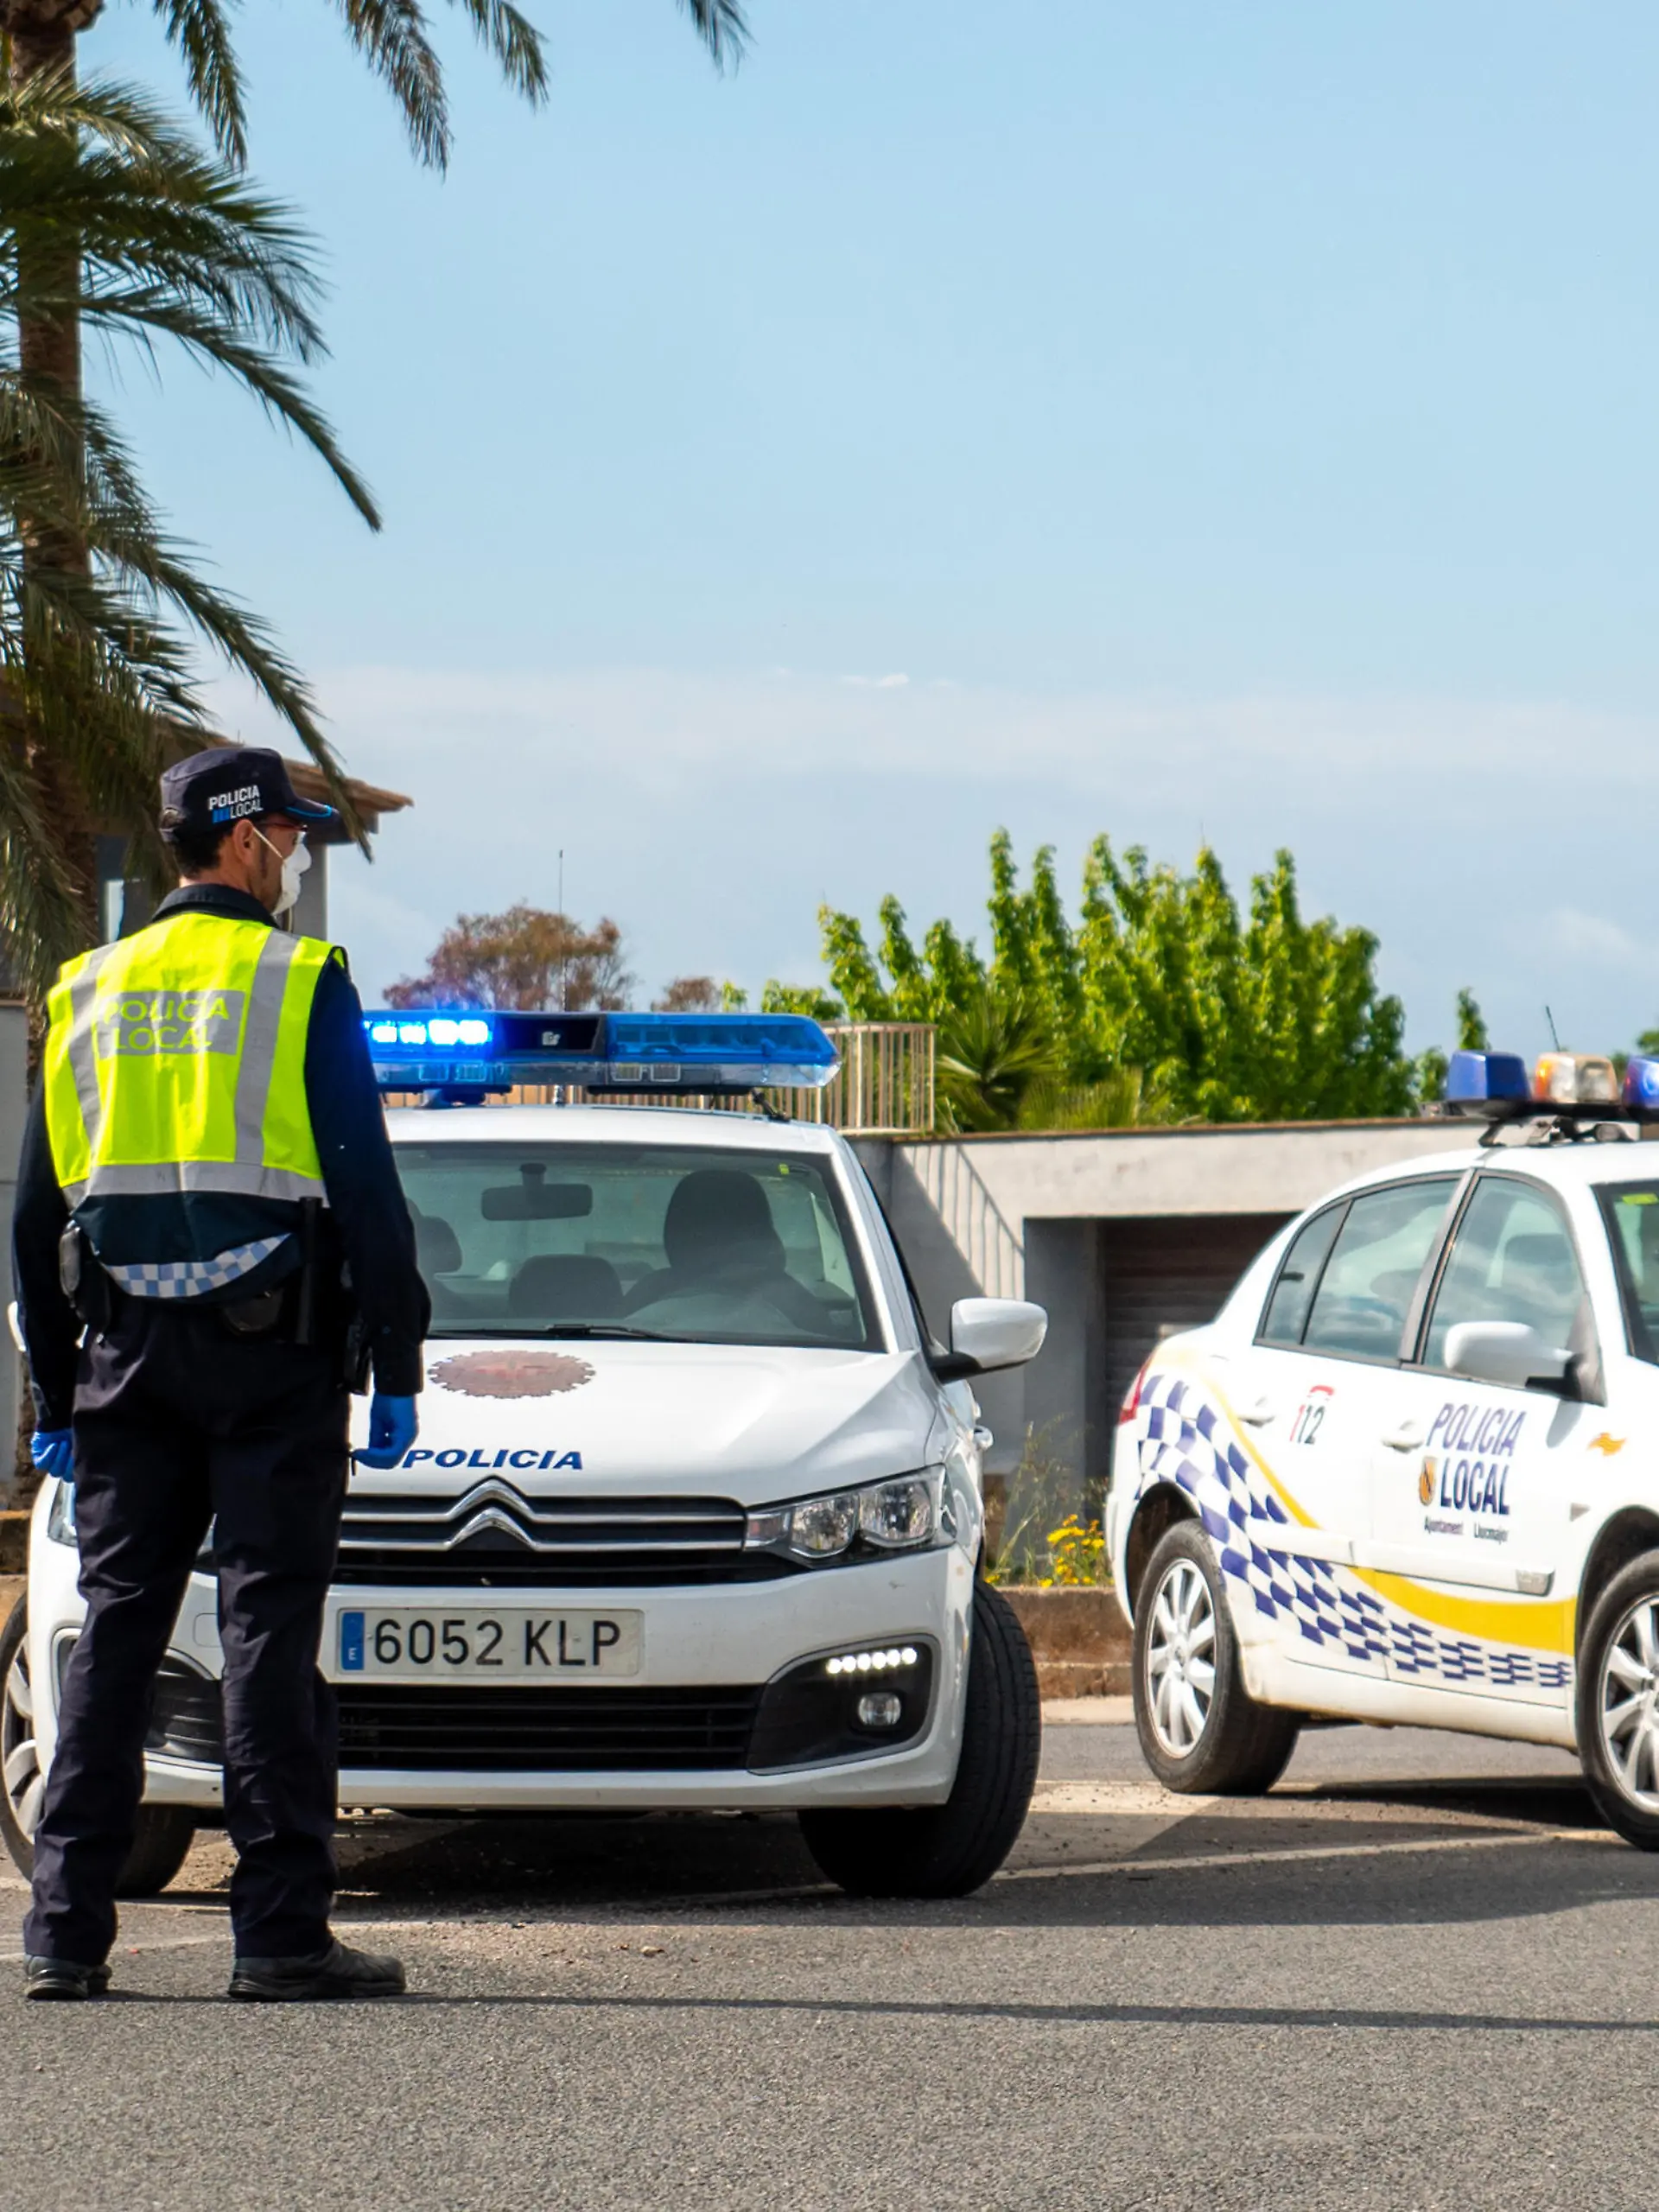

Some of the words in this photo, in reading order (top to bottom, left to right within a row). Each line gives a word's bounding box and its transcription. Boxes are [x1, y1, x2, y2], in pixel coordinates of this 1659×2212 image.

[208, 785, 260, 810] POLICIA
[230, 798, 264, 820] LOCAL
[104, 997, 230, 1025] POLICIA
[113, 1025, 213, 1051] LOCAL
[1289, 1404, 1325, 1445] 112
[1426, 1402, 1527, 1457] POLICIA
[402, 1449, 583, 1470] POLICIA
[1440, 1458, 1511, 1516] LOCAL
[374, 1618, 503, 1666] 6052
[524, 1619, 621, 1666] KLP
